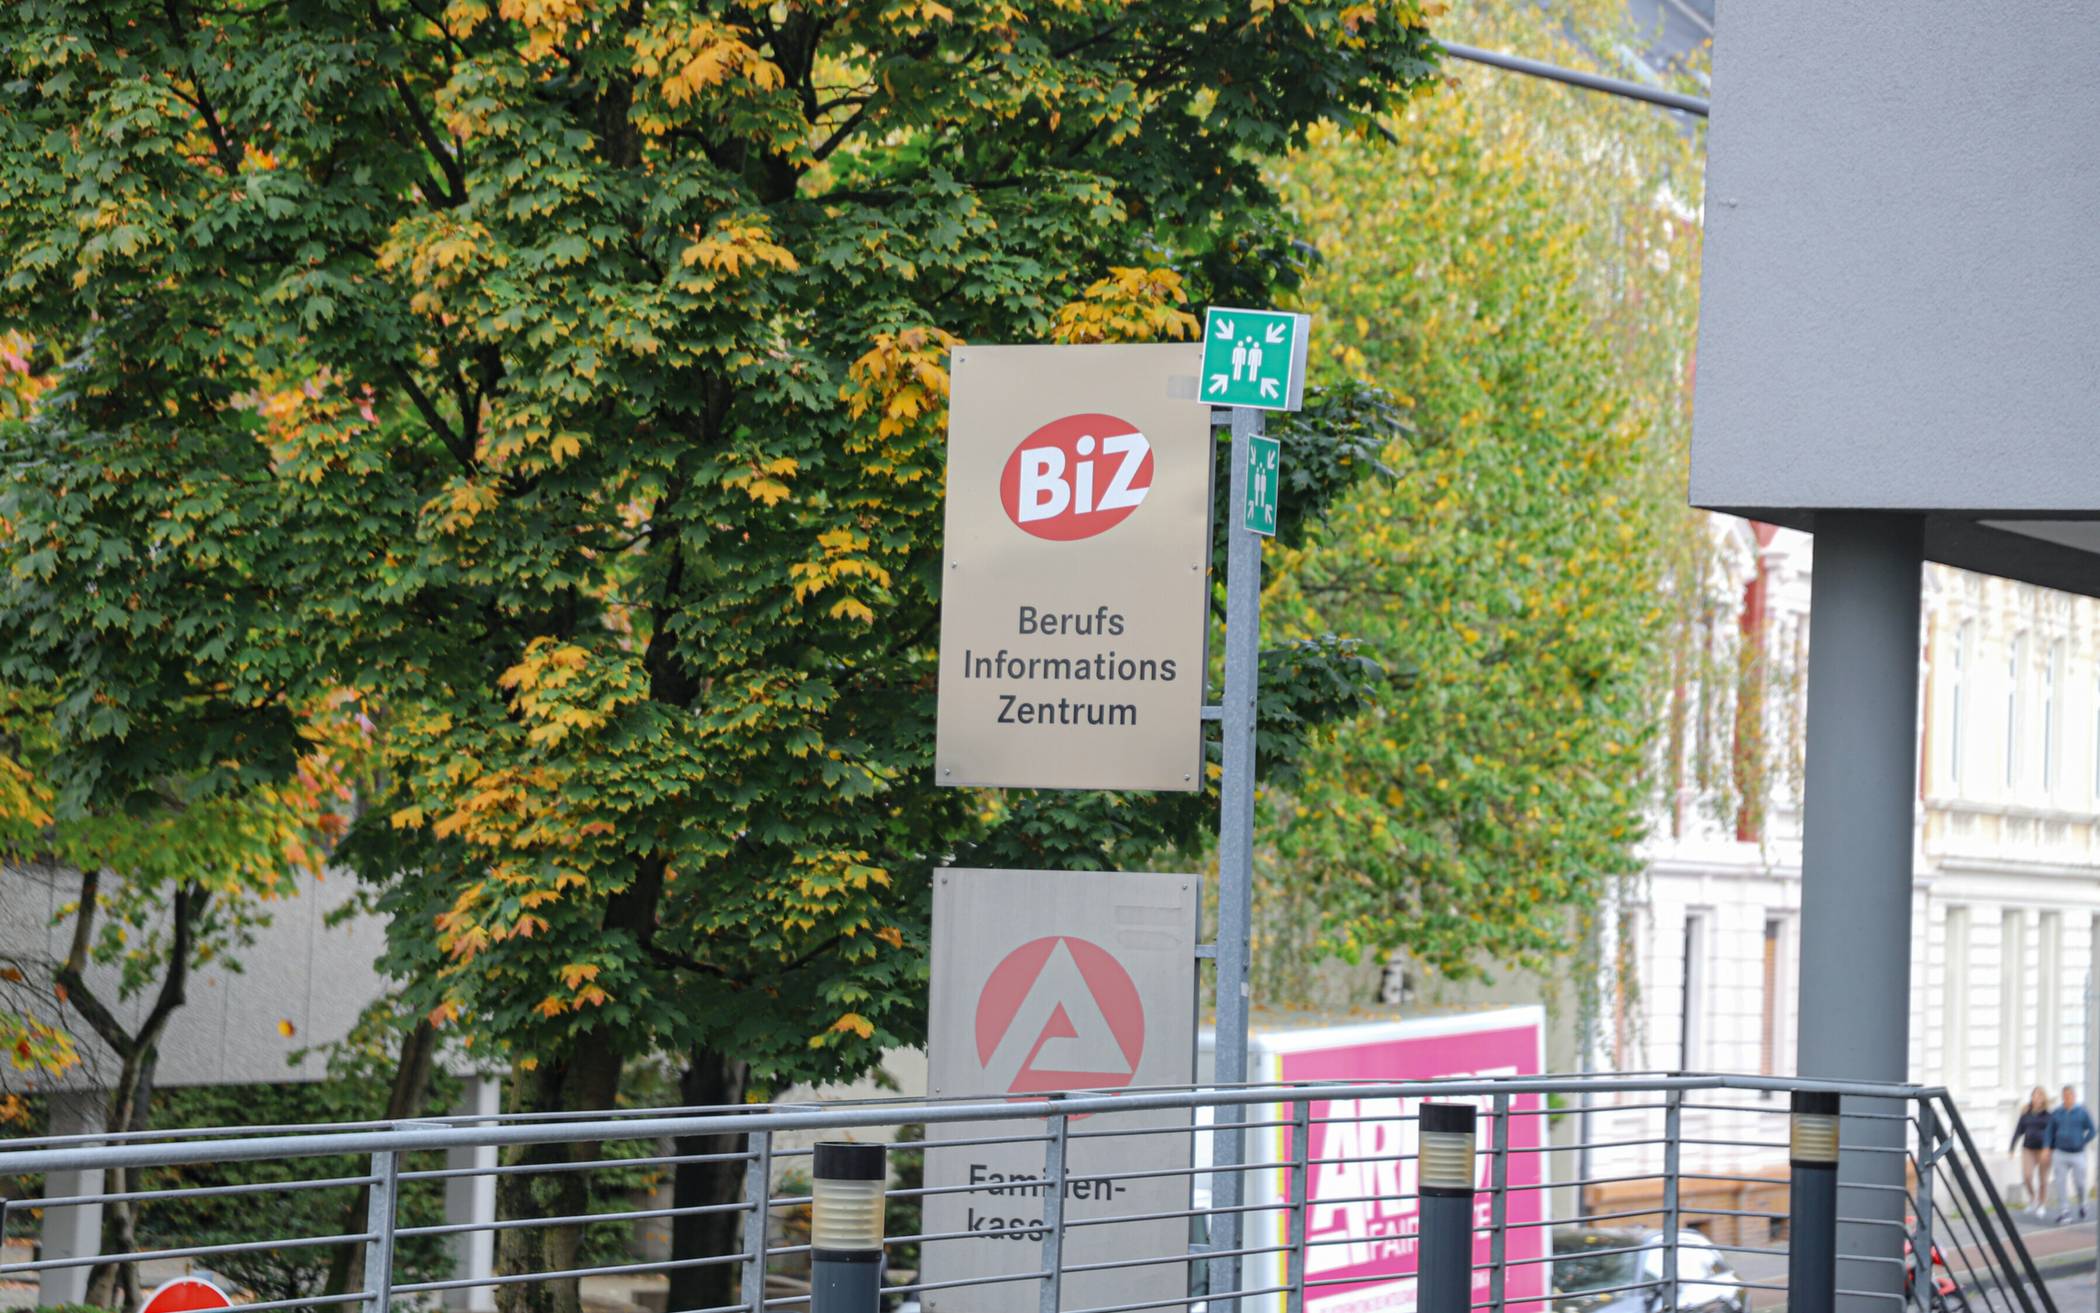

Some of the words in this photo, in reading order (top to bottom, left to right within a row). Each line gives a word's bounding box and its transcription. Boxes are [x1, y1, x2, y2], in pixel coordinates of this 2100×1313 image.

[1018, 432, 1151, 523] BiZ
[1018, 605, 1125, 636] Berufs
[964, 649, 1177, 682] Informations
[997, 694, 1138, 726] Zentrum
[969, 1164, 1126, 1201] Famiien-
[968, 1207, 1066, 1242] kass
